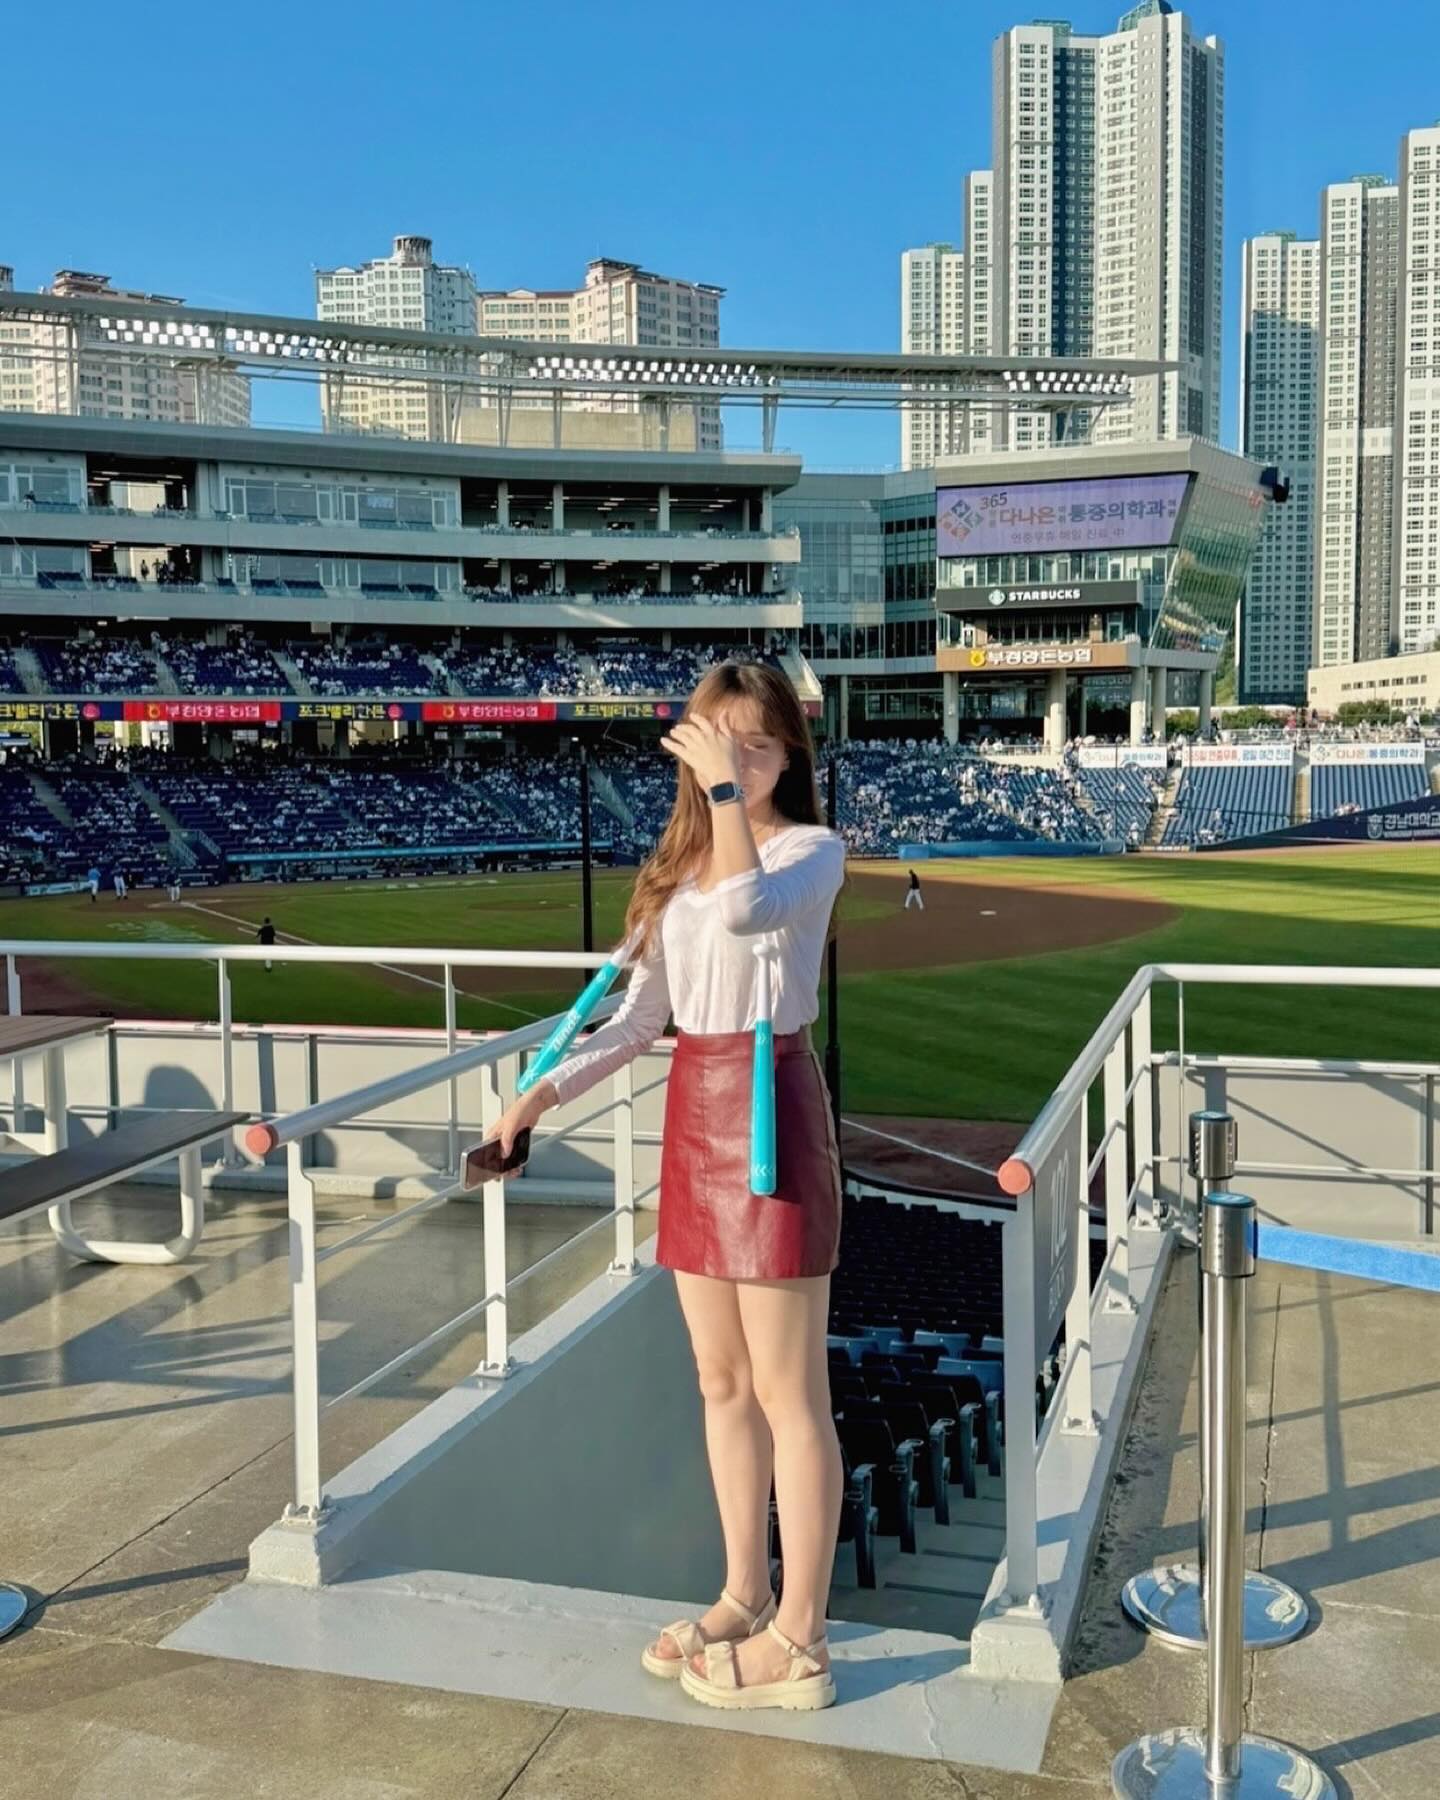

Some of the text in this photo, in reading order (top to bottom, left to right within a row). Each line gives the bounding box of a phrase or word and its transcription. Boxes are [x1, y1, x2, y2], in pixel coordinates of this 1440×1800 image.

[979, 492, 1008, 510] 365
[1000, 506, 1056, 526] 다나은
[1068, 499, 1166, 522] 통증의학과
[1008, 588, 1081, 601] STARBUCKS
[988, 648, 1092, 666] 부경양돈농협
